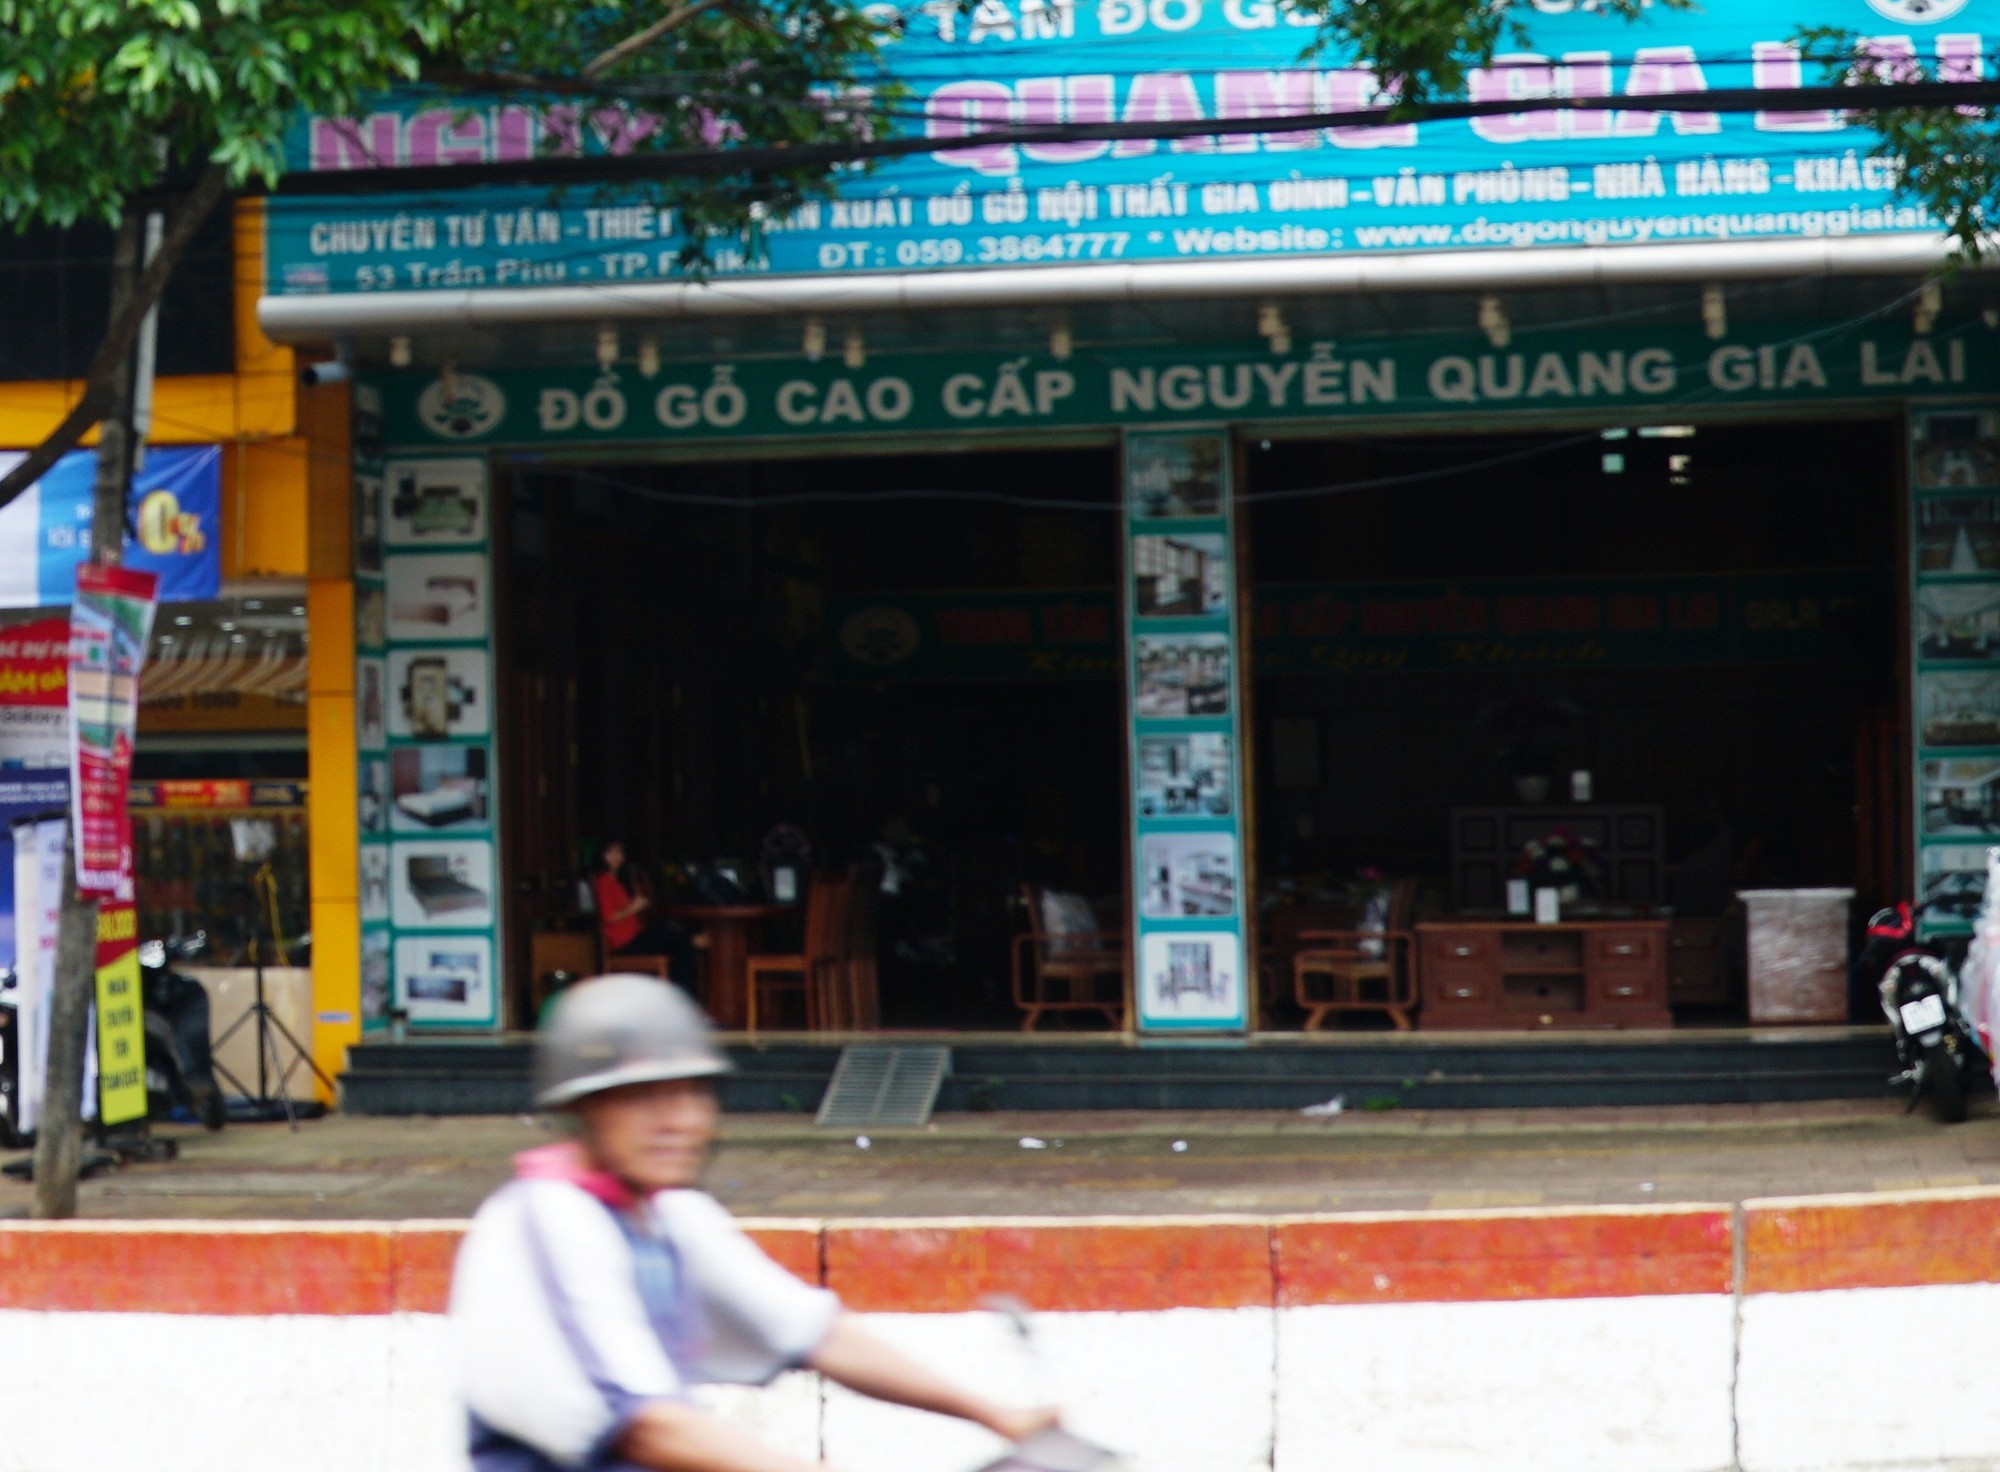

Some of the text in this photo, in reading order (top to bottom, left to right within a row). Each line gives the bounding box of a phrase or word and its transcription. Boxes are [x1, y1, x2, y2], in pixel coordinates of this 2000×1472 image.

[1468, 46, 1722, 143] GIA
[1202, 181, 1259, 216] GIA
[896, 231, 1131, 265] 059.3864777
[654, 363, 748, 429] GỖ
[774, 375, 914, 426] CAO
[941, 355, 1076, 419] CẤP
[1108, 341, 1398, 413] NGUYỄN
[1426, 347, 1678, 403] QUANG
[1706, 342, 1829, 392] GIA
[1858, 338, 1969, 387] LAI
